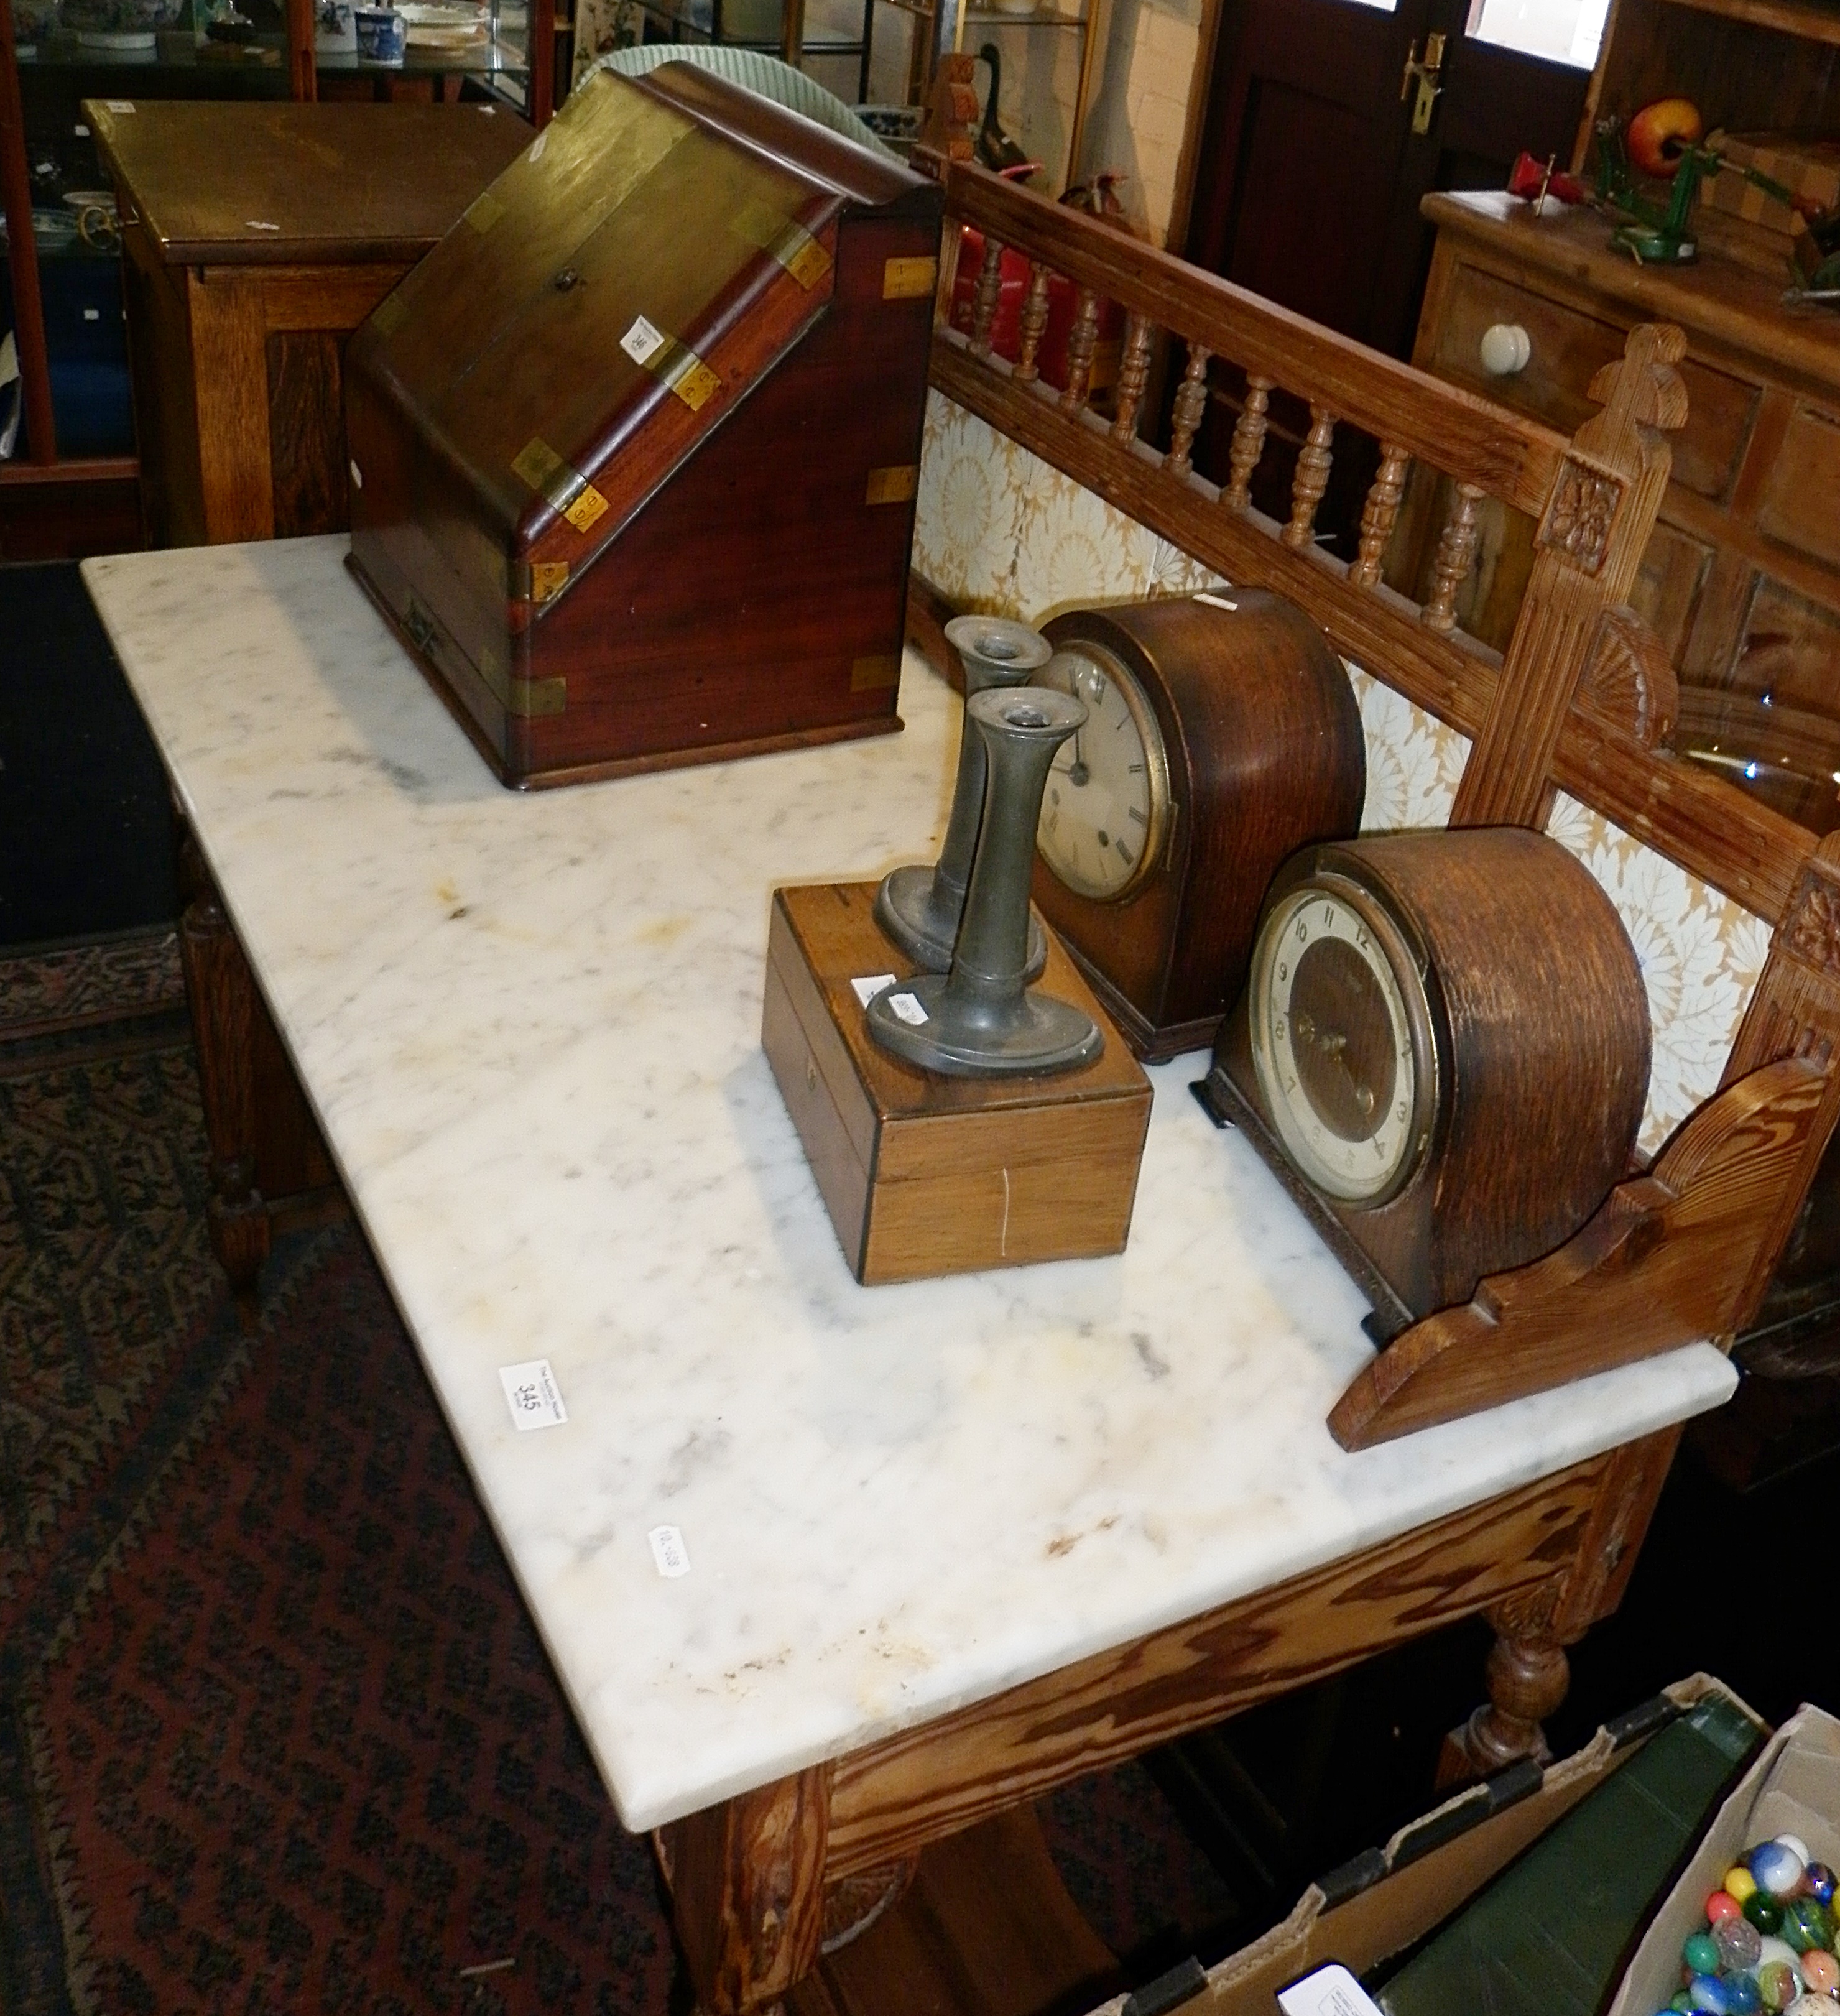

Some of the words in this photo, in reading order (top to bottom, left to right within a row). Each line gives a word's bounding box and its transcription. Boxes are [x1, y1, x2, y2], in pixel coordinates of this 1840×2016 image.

[1324, 905, 1334, 928] 11
[1295, 917, 1308, 943] 10
[1278, 961, 1288, 982] 9
[519, 1384, 541, 1410] 345
